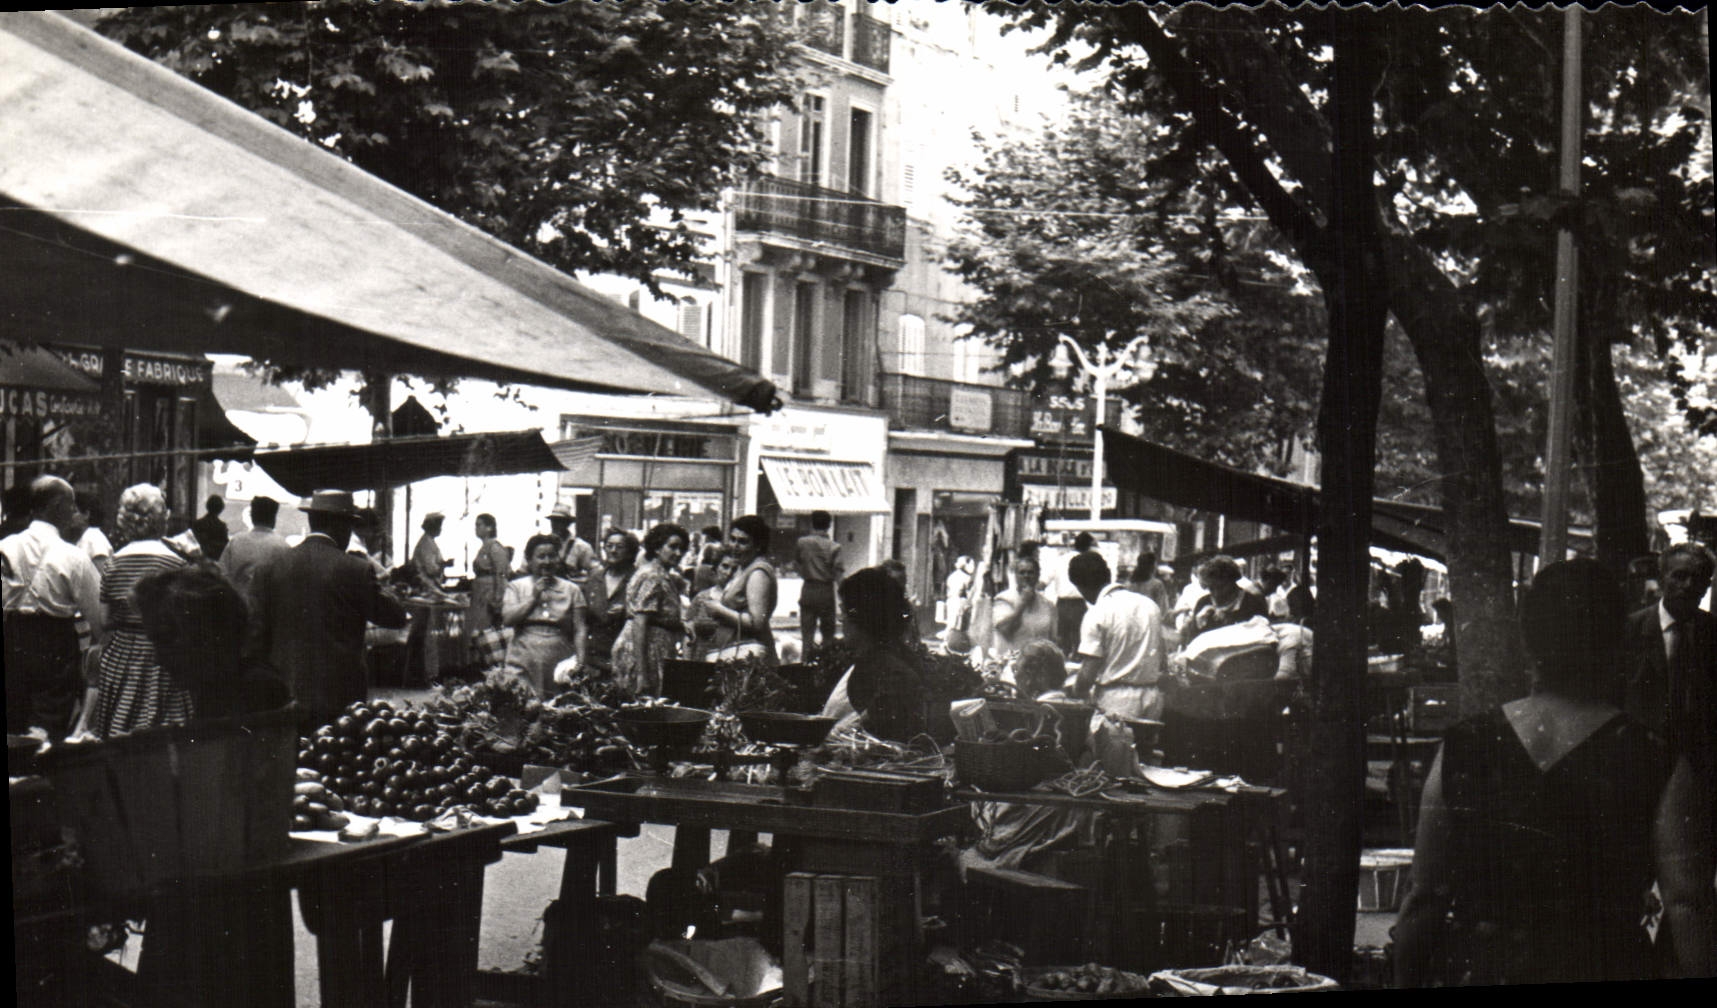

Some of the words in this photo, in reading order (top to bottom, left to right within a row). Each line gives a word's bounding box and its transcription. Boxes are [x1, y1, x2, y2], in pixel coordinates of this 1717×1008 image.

[136, 357, 205, 385] FABRIQUE
[234, 478, 243, 493] 3
[776, 465, 800, 497] LE
[797, 467, 836, 498] BON
[828, 468, 870, 498] LAIT
